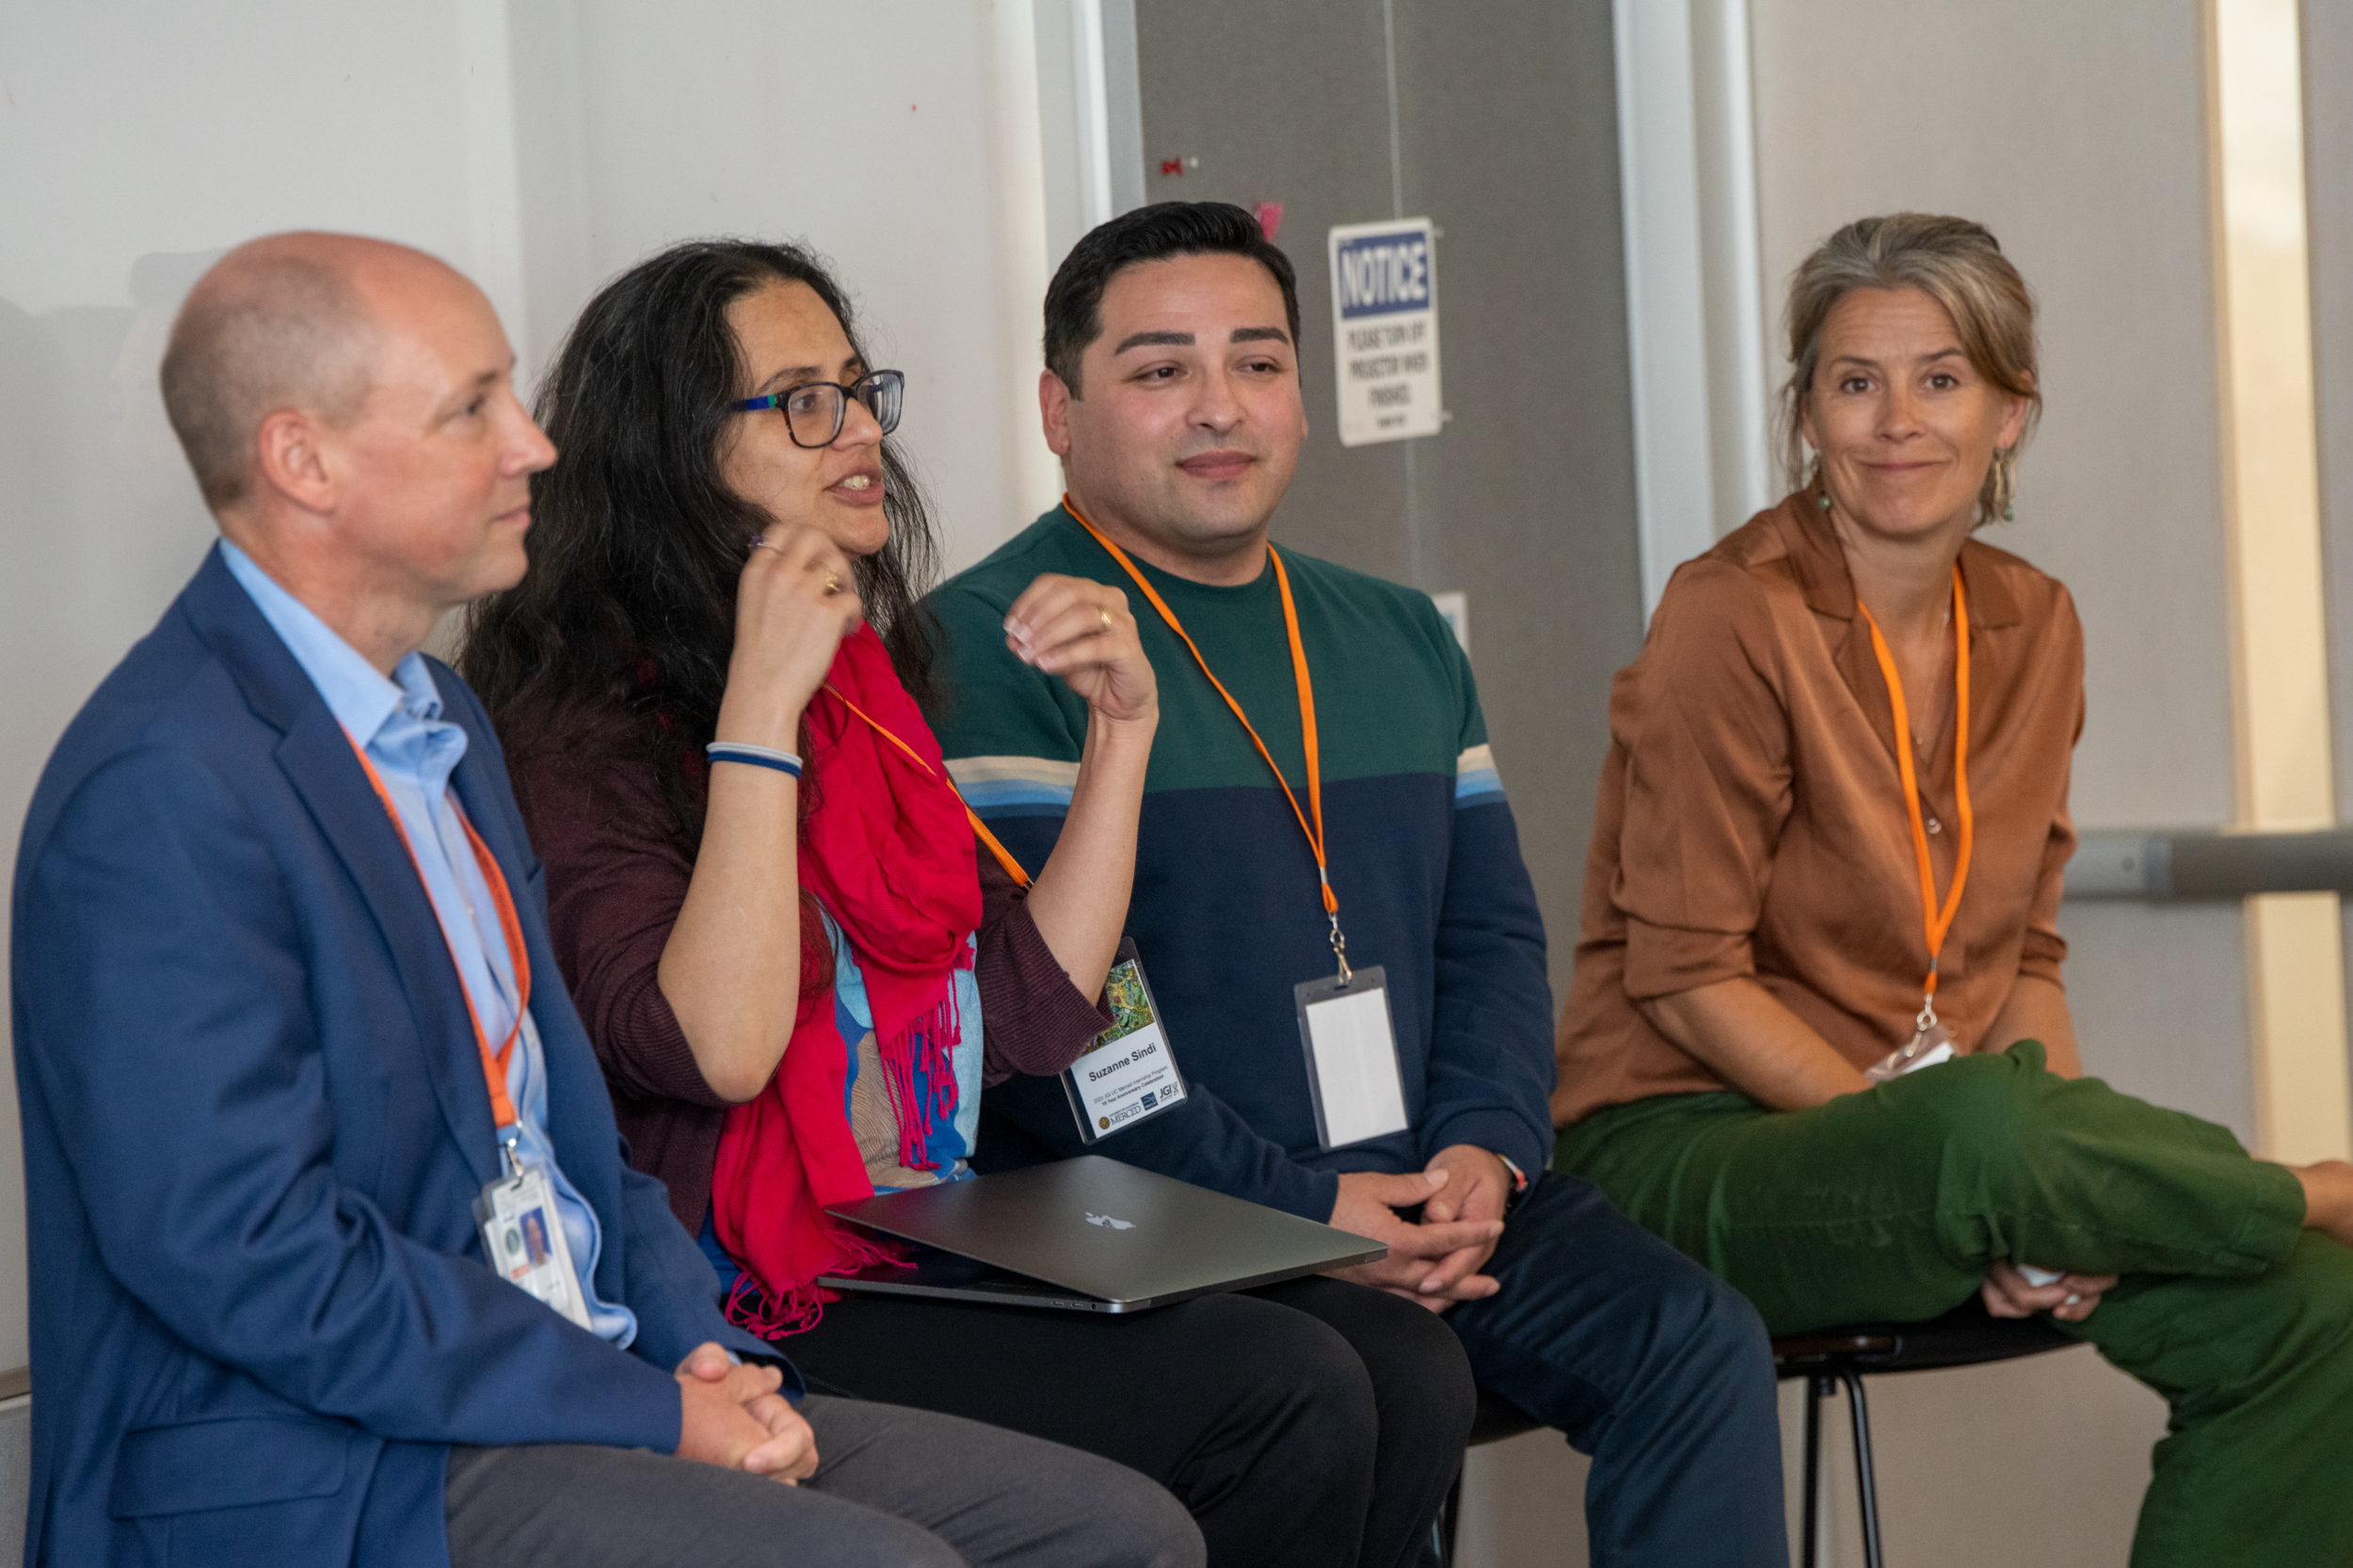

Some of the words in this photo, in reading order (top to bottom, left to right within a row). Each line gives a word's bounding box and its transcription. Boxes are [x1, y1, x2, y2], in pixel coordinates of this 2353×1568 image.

[1341, 242, 1427, 308] NOTICE
[1089, 1058, 1130, 1081] Suzanne
[1131, 1043, 1157, 1062] Sindi
[1107, 1096, 1117, 1104] Year
[1117, 1085, 1141, 1100] Anniversary
[1142, 1074, 1164, 1088] Celebration
[1118, 1081, 1132, 1092] Merced
[1132, 1073, 1151, 1087] Internship
[1151, 1065, 1168, 1079] Program
[1160, 1084, 1173, 1098] JGI
[1111, 1105, 1142, 1126] MERCED
